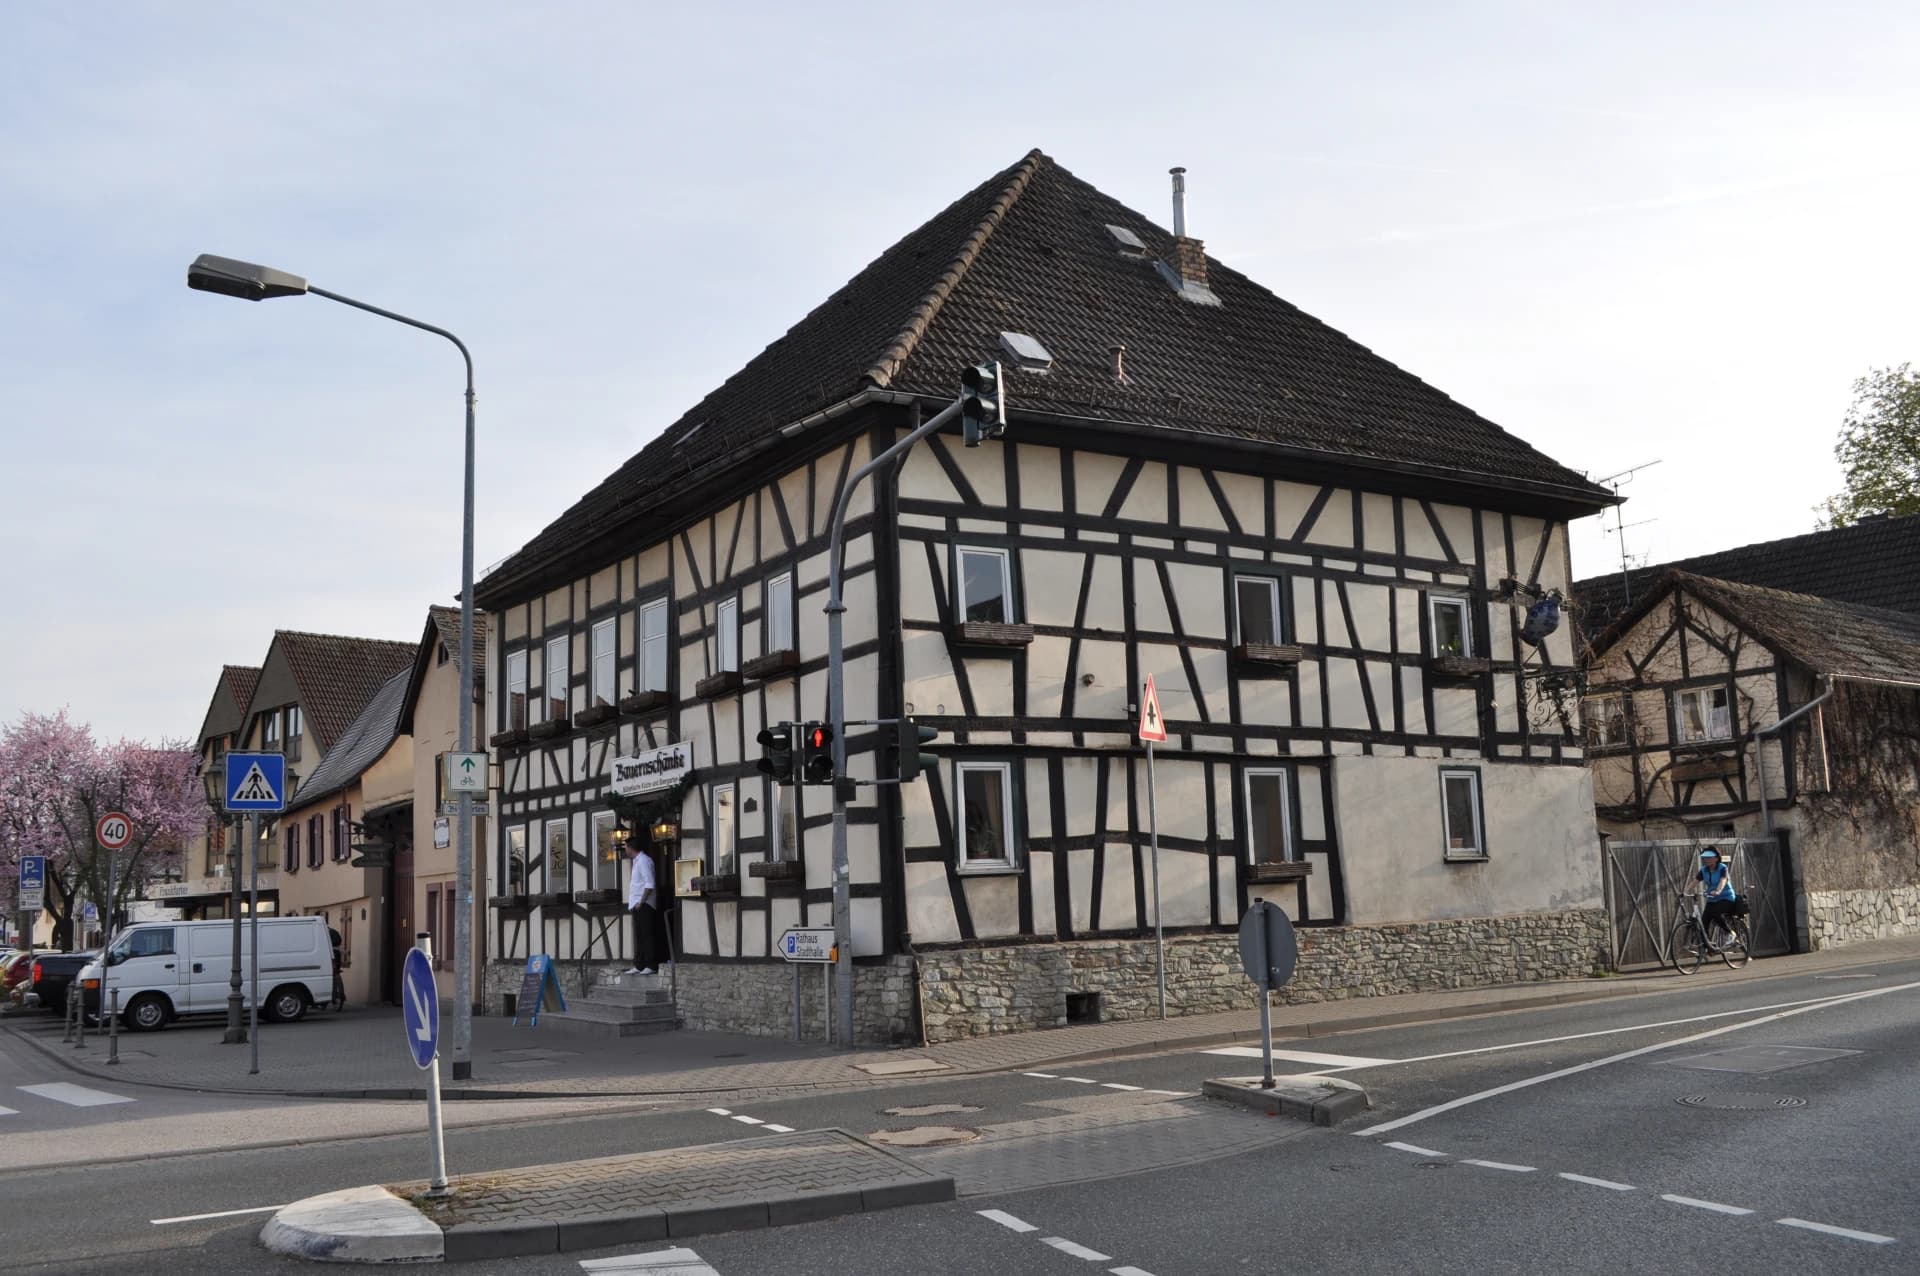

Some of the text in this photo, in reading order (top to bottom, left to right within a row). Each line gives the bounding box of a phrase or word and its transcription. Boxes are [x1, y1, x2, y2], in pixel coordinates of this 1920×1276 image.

[616, 747, 684, 782] Bauernschänke
[104, 822, 126, 839] 40
[796, 933, 818, 943] Rathaus
